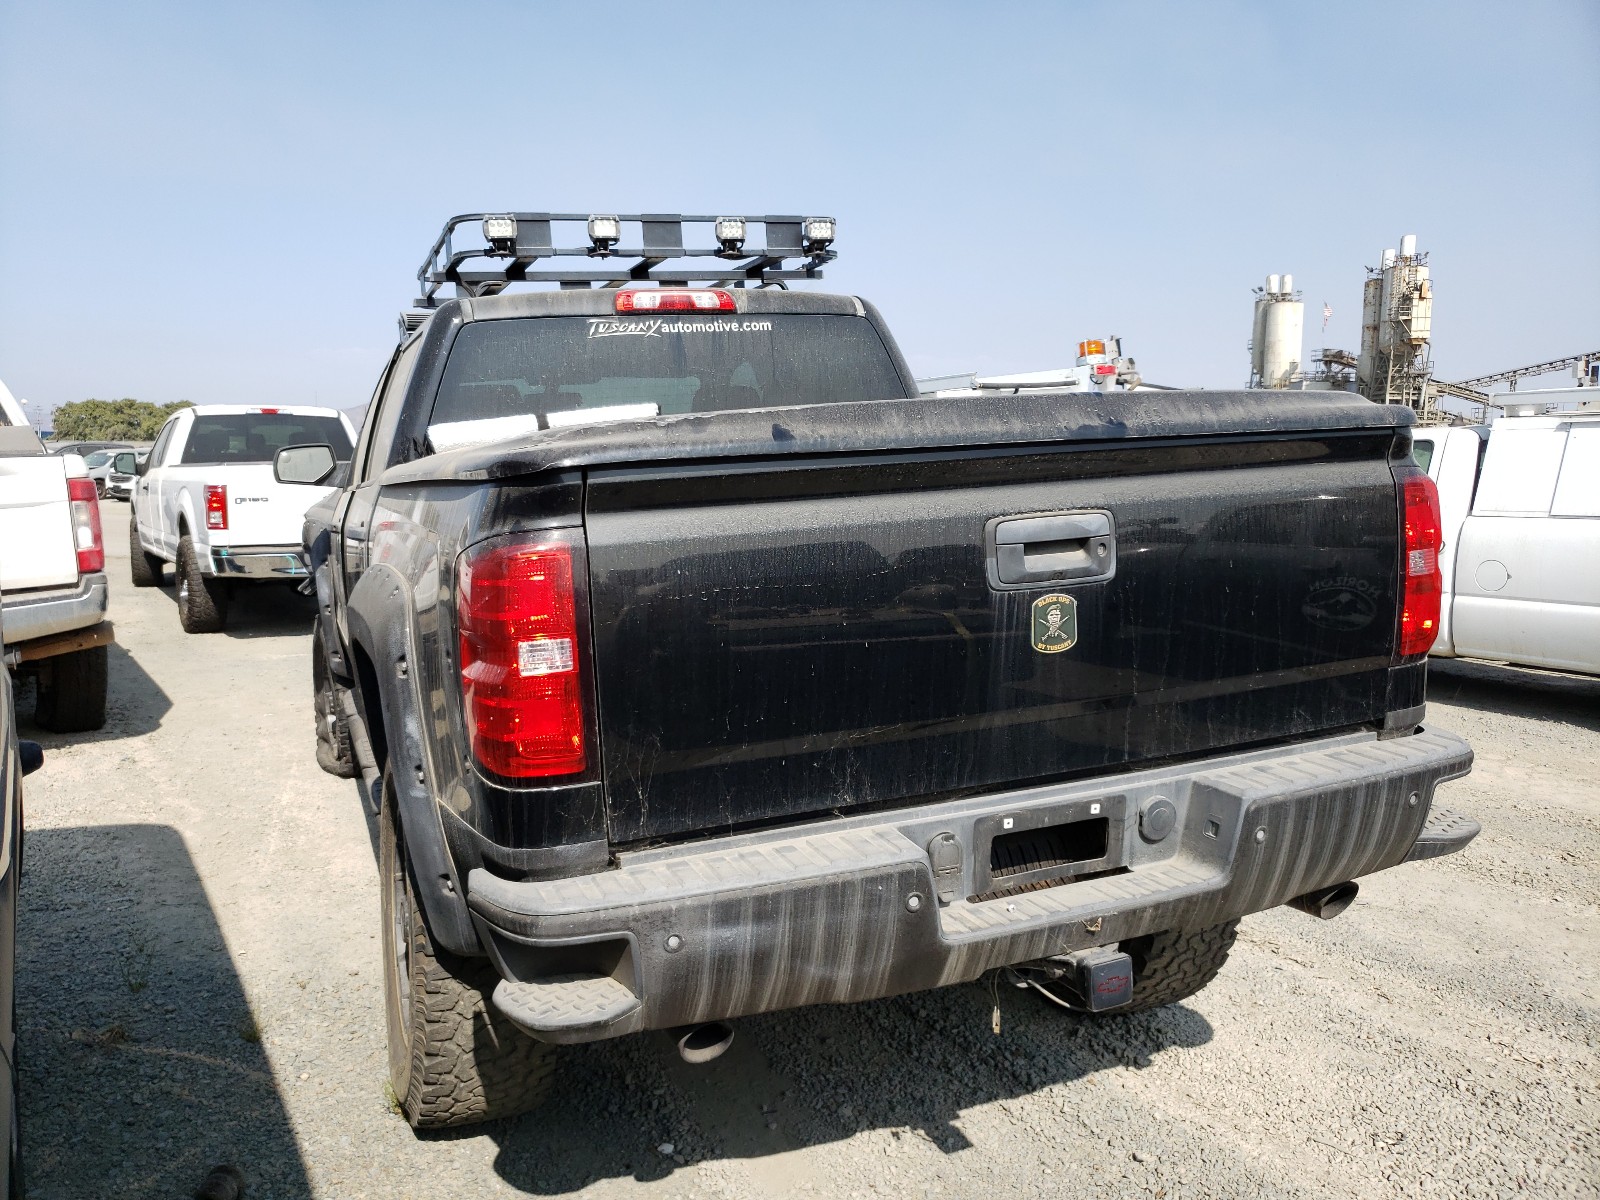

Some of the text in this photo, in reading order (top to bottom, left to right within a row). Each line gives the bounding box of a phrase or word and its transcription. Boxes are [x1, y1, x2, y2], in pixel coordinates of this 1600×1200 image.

[1037, 596, 1071, 608] BLACK OPS
[1037, 639, 1072, 651] BY TUSCANY
